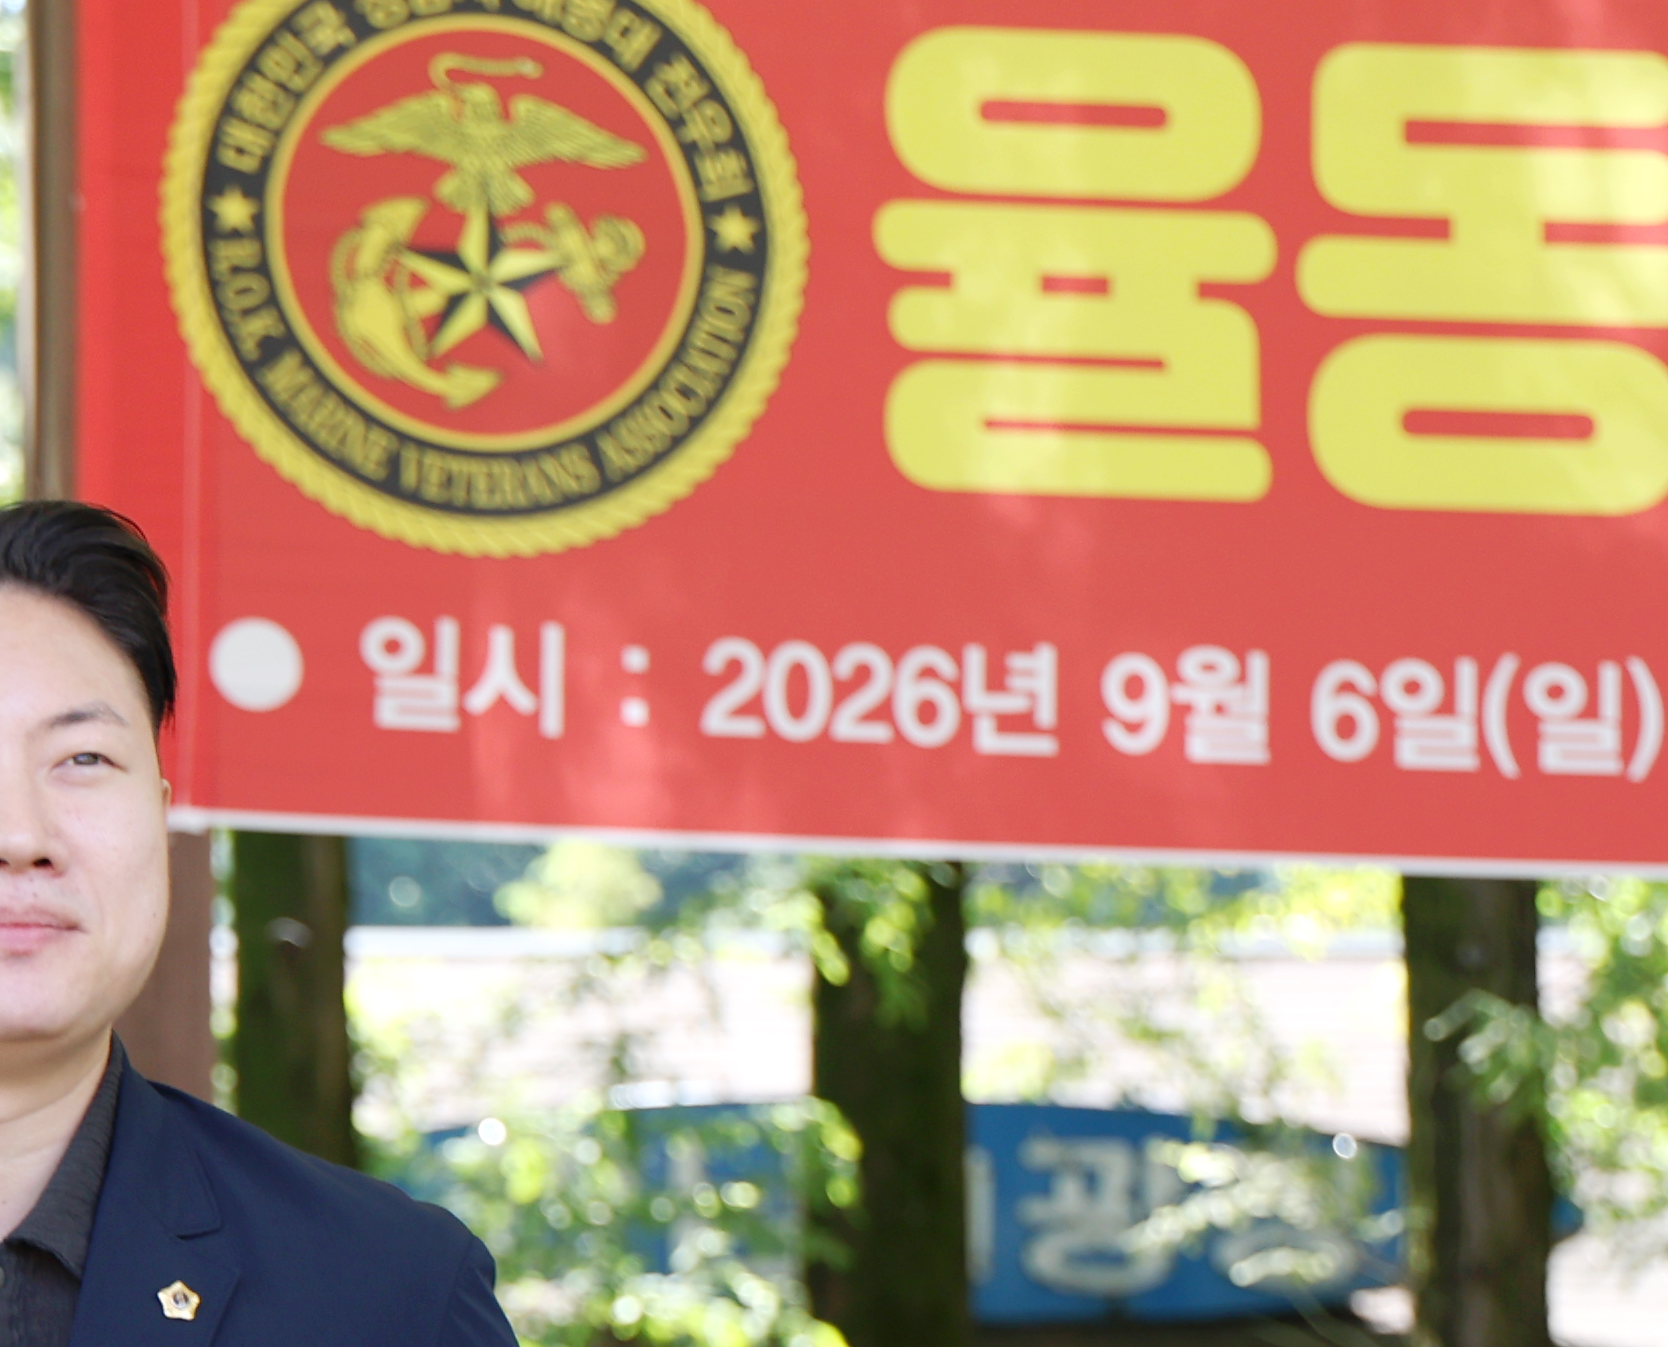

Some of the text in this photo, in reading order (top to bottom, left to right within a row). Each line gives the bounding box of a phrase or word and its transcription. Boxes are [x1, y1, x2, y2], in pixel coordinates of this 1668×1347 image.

[216, 0, 358, 175] 대한민국
[644, 53, 755, 203] 전우회
[871, 24, 1668, 518] 율동
[256, 346, 400, 481] MARINE
[398, 441, 602, 509] VETERANS
[594, 265, 758, 483] ASSOCIATION
[358, 615, 566, 740] 일시
[698, 635, 1060, 758] 2026년
[1099, 643, 1271, 766] 9월
[1309, 651, 1666, 783] 6일(일)
